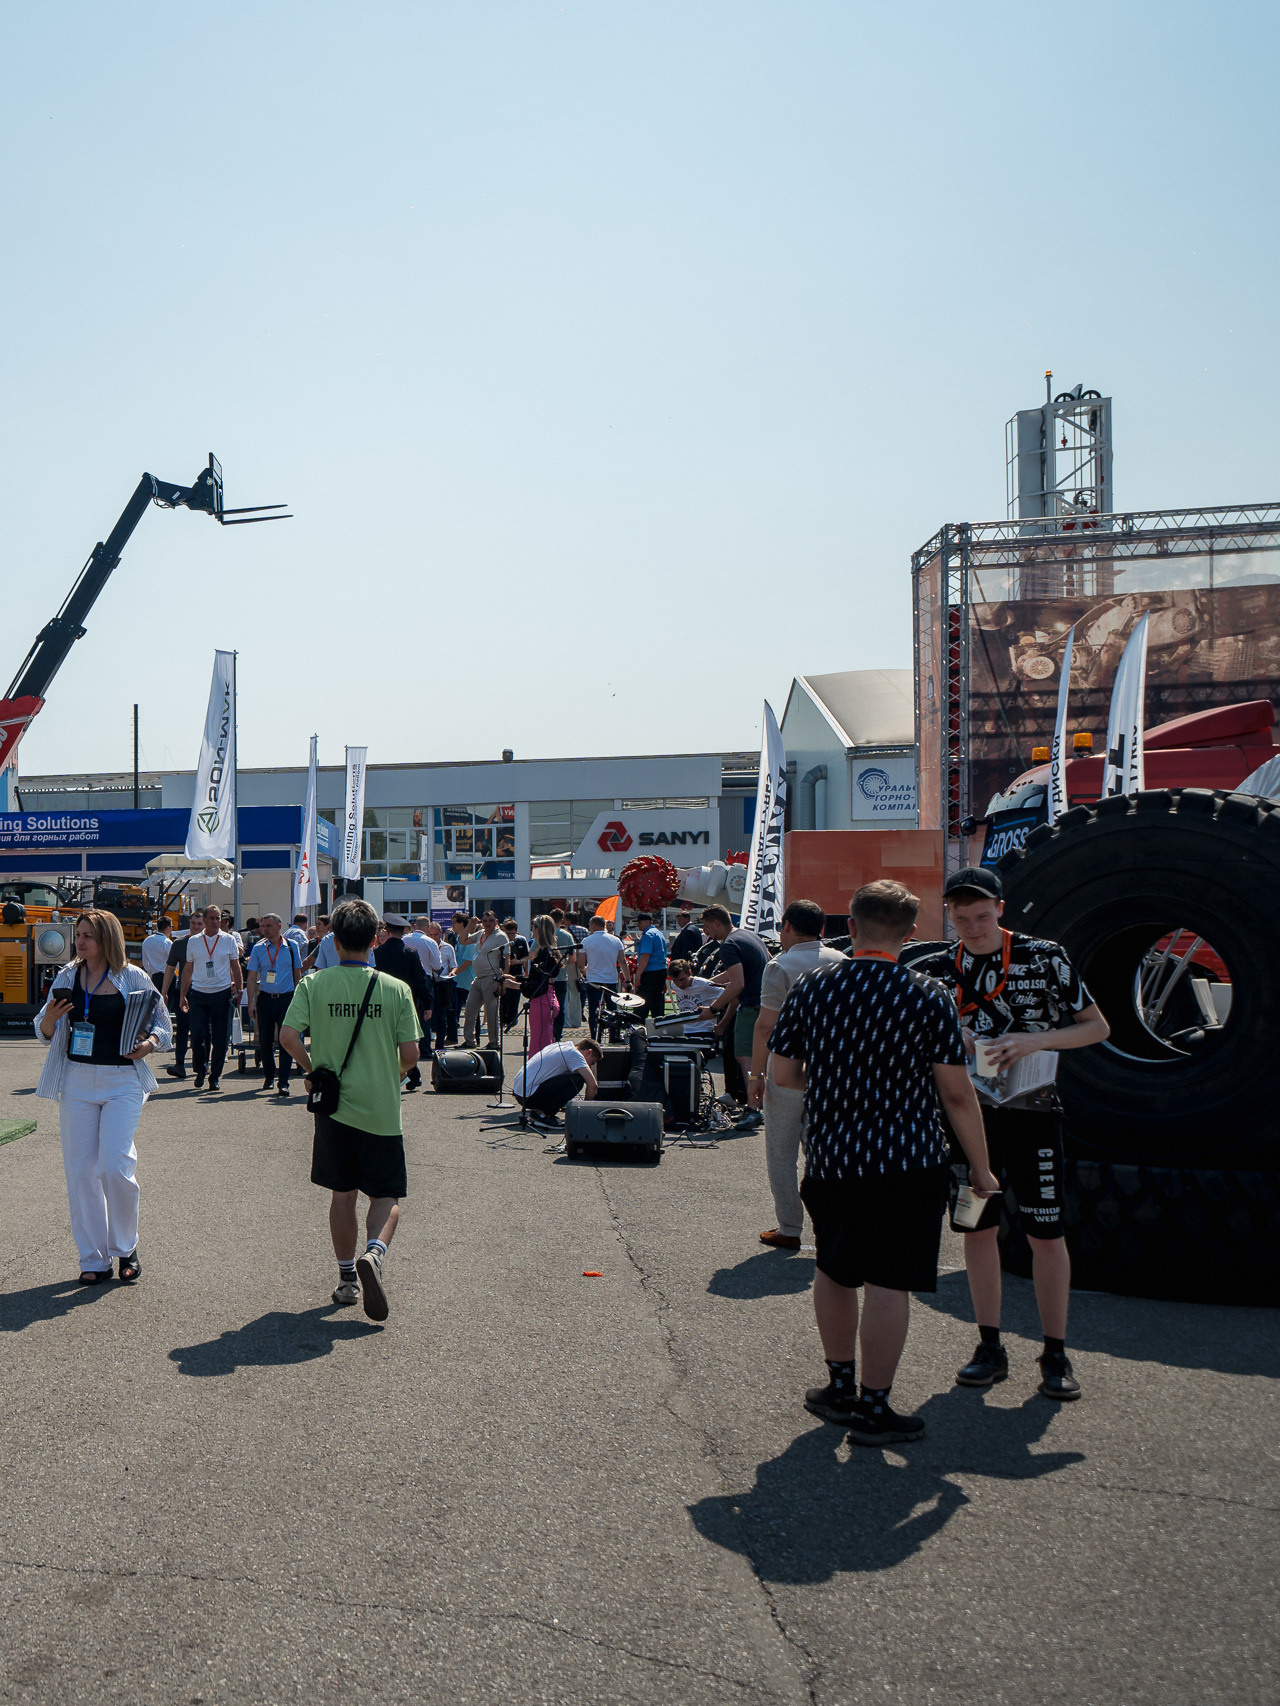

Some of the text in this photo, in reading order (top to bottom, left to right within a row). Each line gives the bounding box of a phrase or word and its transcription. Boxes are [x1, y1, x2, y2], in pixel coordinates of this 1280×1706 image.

[1051, 734, 1063, 803] ДИСКИ
[27, 816, 99, 829] Solutions
[14, 834, 30, 842] для
[32, 834, 66, 843] горных
[68, 832, 99, 843] работ
[638, 831, 710, 845] SANYI
[1037, 1148, 1055, 1199] CREW
